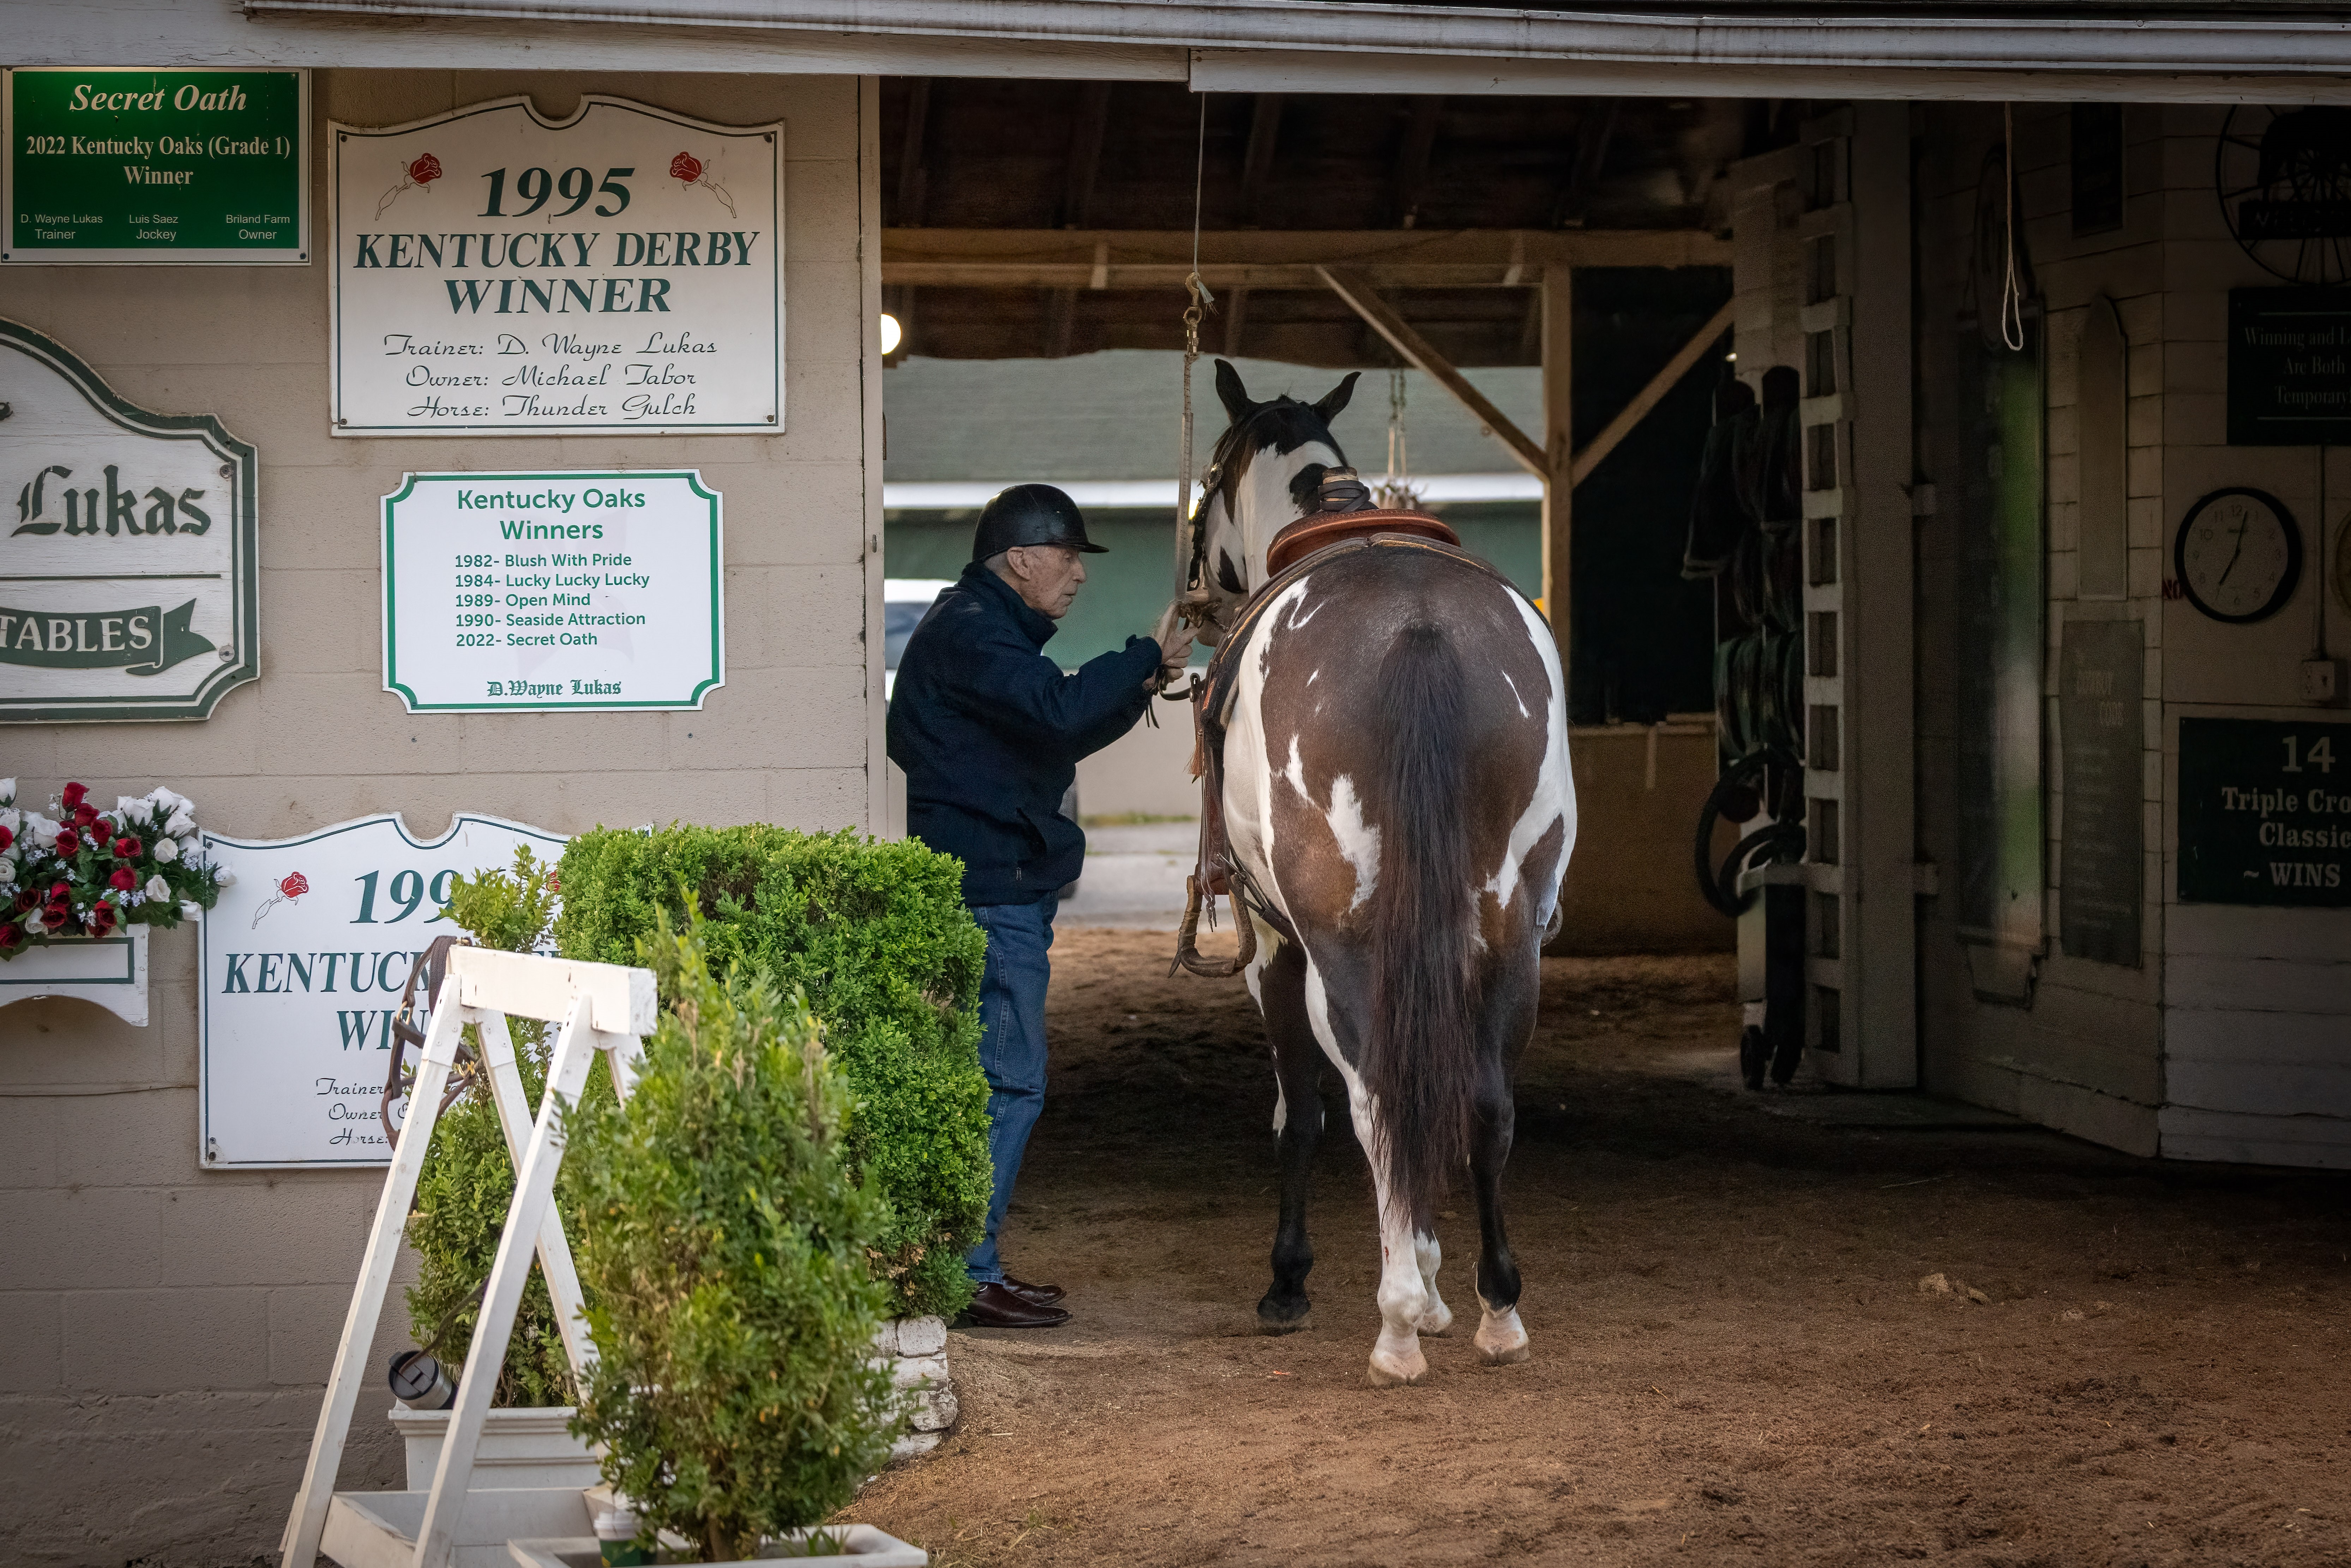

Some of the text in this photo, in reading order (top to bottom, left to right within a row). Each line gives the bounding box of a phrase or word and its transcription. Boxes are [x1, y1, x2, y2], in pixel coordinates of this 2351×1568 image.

[69, 84, 246, 111] Secret Oath
[26, 136, 290, 159] 2022 Kentucky Oaks (Grade 1)
[123, 166, 193, 185] Winner
[477, 167, 635, 219] 1995
[21, 214, 103, 225] D. Wayne Lukas
[129, 214, 179, 223] Luis Saez
[226, 214, 290, 223] Briland Farm
[35, 229, 76, 239] Trainer
[136, 229, 176, 242] Jockey
[239, 229, 277, 239] Owner
[353, 231, 760, 268] KENTUCKY DERBY
[444, 276, 671, 314] WINNER
[384, 331, 717, 361] Trainer: D. Wayne Lukas
[2244, 327, 2305, 352] Winning
[2309, 326, 2335, 345] and
[406, 363, 696, 387] Owner: Michael Tabor
[2283, 355, 2346, 375] Are Both
[407, 393, 696, 420] Horse: Thunder Gulch
[10, 464, 211, 538] Lukas
[458, 488, 645, 513] Kentucky Oaks
[500, 520, 603, 539] Winners
[455, 553, 632, 567] 1982- Blush With Pride
[456, 573, 650, 590] 1984- Lucky Lucky Lucky
[456, 593, 590, 610] 1989- Open Mind
[456, 612, 645, 627] 1990- Seaside Attraction
[0, 614, 153, 652] TABLES
[456, 632, 597, 646] 2022- Secret Oath
[487, 679, 621, 699] D.Wayne Lukas
[2281, 735, 2336, 773] 14
[2221, 786, 2298, 818] Triple
[2269, 862, 2340, 887] WINS
